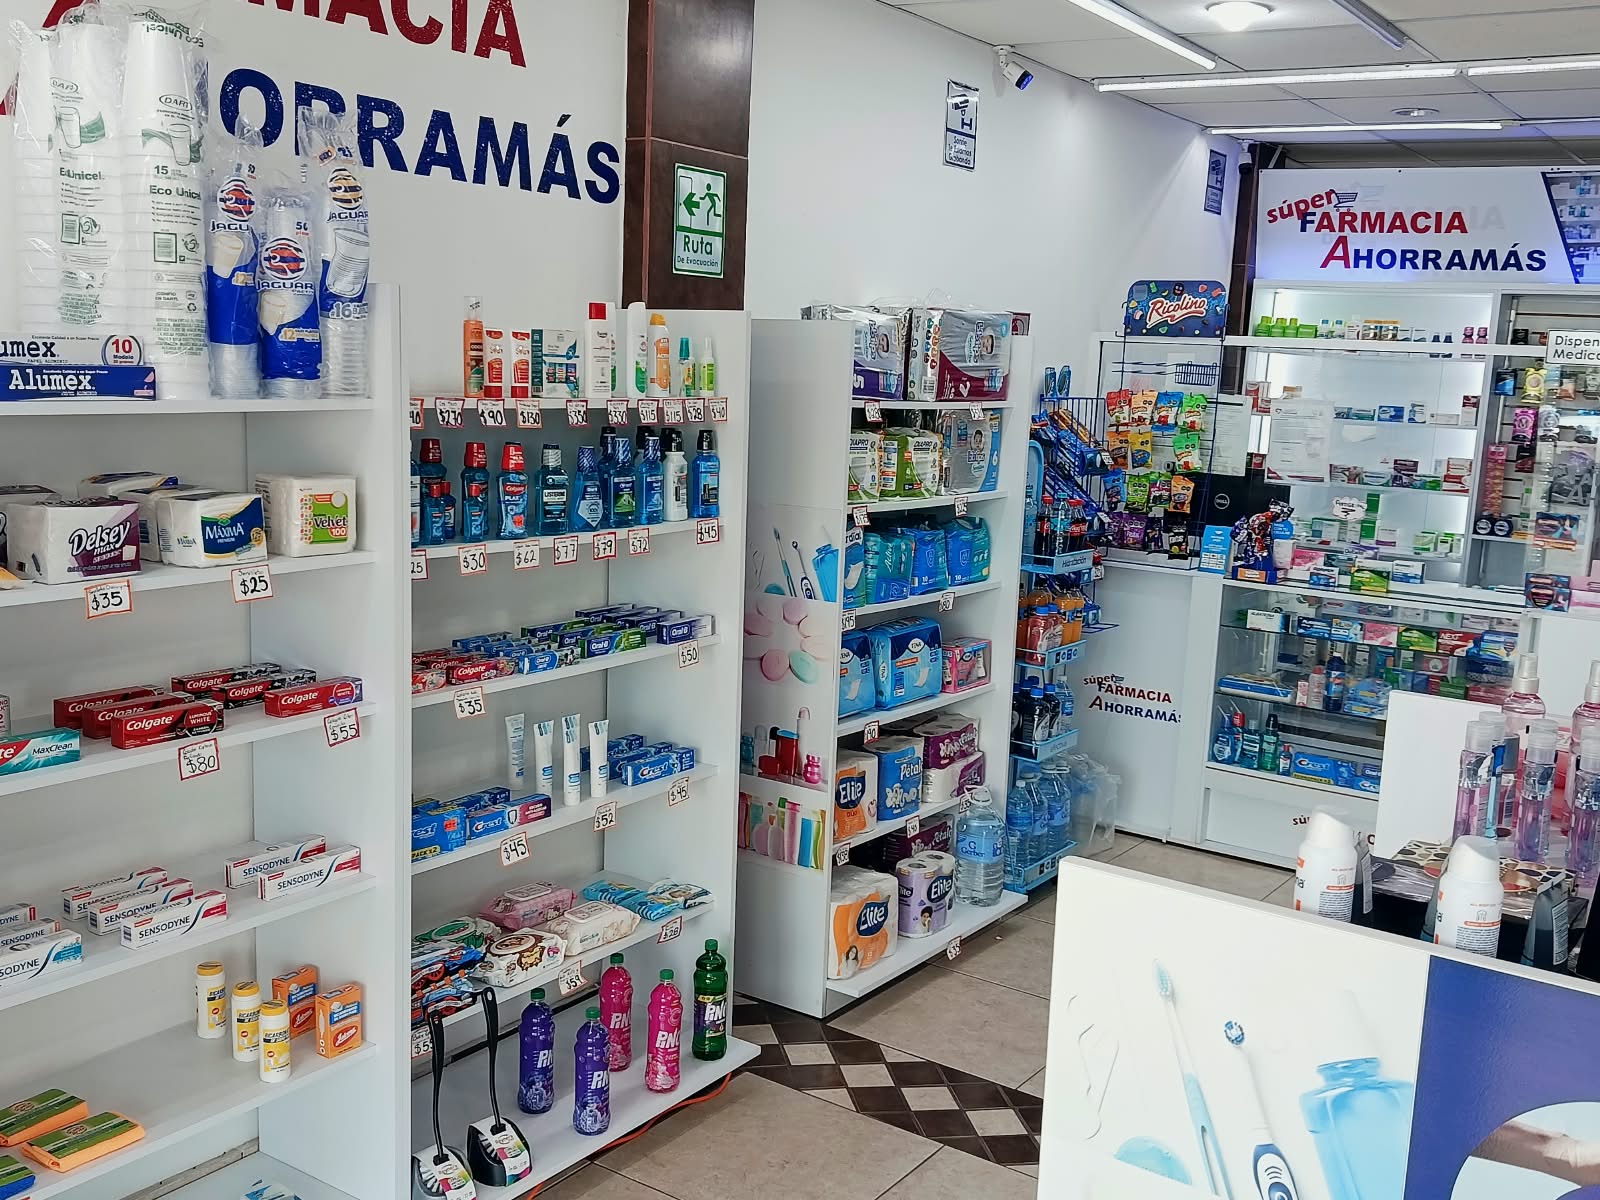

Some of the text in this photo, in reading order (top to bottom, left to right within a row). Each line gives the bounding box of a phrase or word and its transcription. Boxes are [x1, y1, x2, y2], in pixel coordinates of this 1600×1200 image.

[154, 165, 169, 175] 15
[149, 185, 172, 196] Eco
[1267, 188, 1337, 225] súper
[1300, 211, 1468, 234] FARMACIA
[683, 234, 713, 256] Ruta
[1319, 235, 1547, 272] AHORRAMÁS
[677, 255, 719, 268] De Evacuación
[257, 280, 314, 291] JAGUAR
[1149, 294, 1208, 323] Ricolino
[111, 338, 133, 354] 10
[1555, 335, 1600, 348] Dispen
[8, 368, 96, 391] Alumex.
[438, 410, 464, 426] $270
[479, 408, 504, 426] $90
[519, 410, 541, 425] $130
[687, 406, 703, 421] $28
[712, 406, 726, 420] $40
[991, 452, 999, 466] 6
[314, 515, 348, 528] Velvet
[69, 520, 132, 557] Delsey
[332, 527, 346, 536] 100
[697, 523, 718, 542] $45
[93, 542, 117, 557] max
[556, 543, 577, 560] $77
[594, 539, 613, 558] $79
[631, 538, 649, 553] $72
[462, 551, 486, 571] $30
[515, 549, 537, 566] $62
[239, 575, 269, 597] $25
[92, 591, 123, 611] $35
[671, 626, 689, 637] Oral-B
[591, 641, 609, 651] Oral-B
[681, 647, 698, 665] $50
[457, 665, 487, 677] Colgate
[1082, 673, 1116, 686] súper
[186, 676, 224, 690] Colgate
[229, 684, 264, 698] Colgate
[281, 690, 320, 706] Colgate
[1097, 682, 1172, 704] FARMACIA
[458, 699, 483, 716] $35
[126, 714, 175, 732] Colgate
[190, 716, 212, 725] WHITE
[331, 724, 358, 742] $55
[32, 742, 74, 757] MaxClean
[185, 755, 217, 774] $80
[639, 762, 669, 779] Crest
[670, 787, 687, 802] $45
[839, 780, 862, 804] Elite
[473, 817, 503, 833] Crest
[595, 812, 615, 829] $52
[502, 839, 527, 862] $45
[243, 856, 291, 877] SENSODYNE
[277, 868, 325, 890] SENSODYNE
[930, 877, 952, 899] Elite
[859, 903, 885, 931] Elite
[139, 915, 191, 939] SENSODYNE
[662, 926, 679, 940] $28
[565, 974, 583, 990] $59
